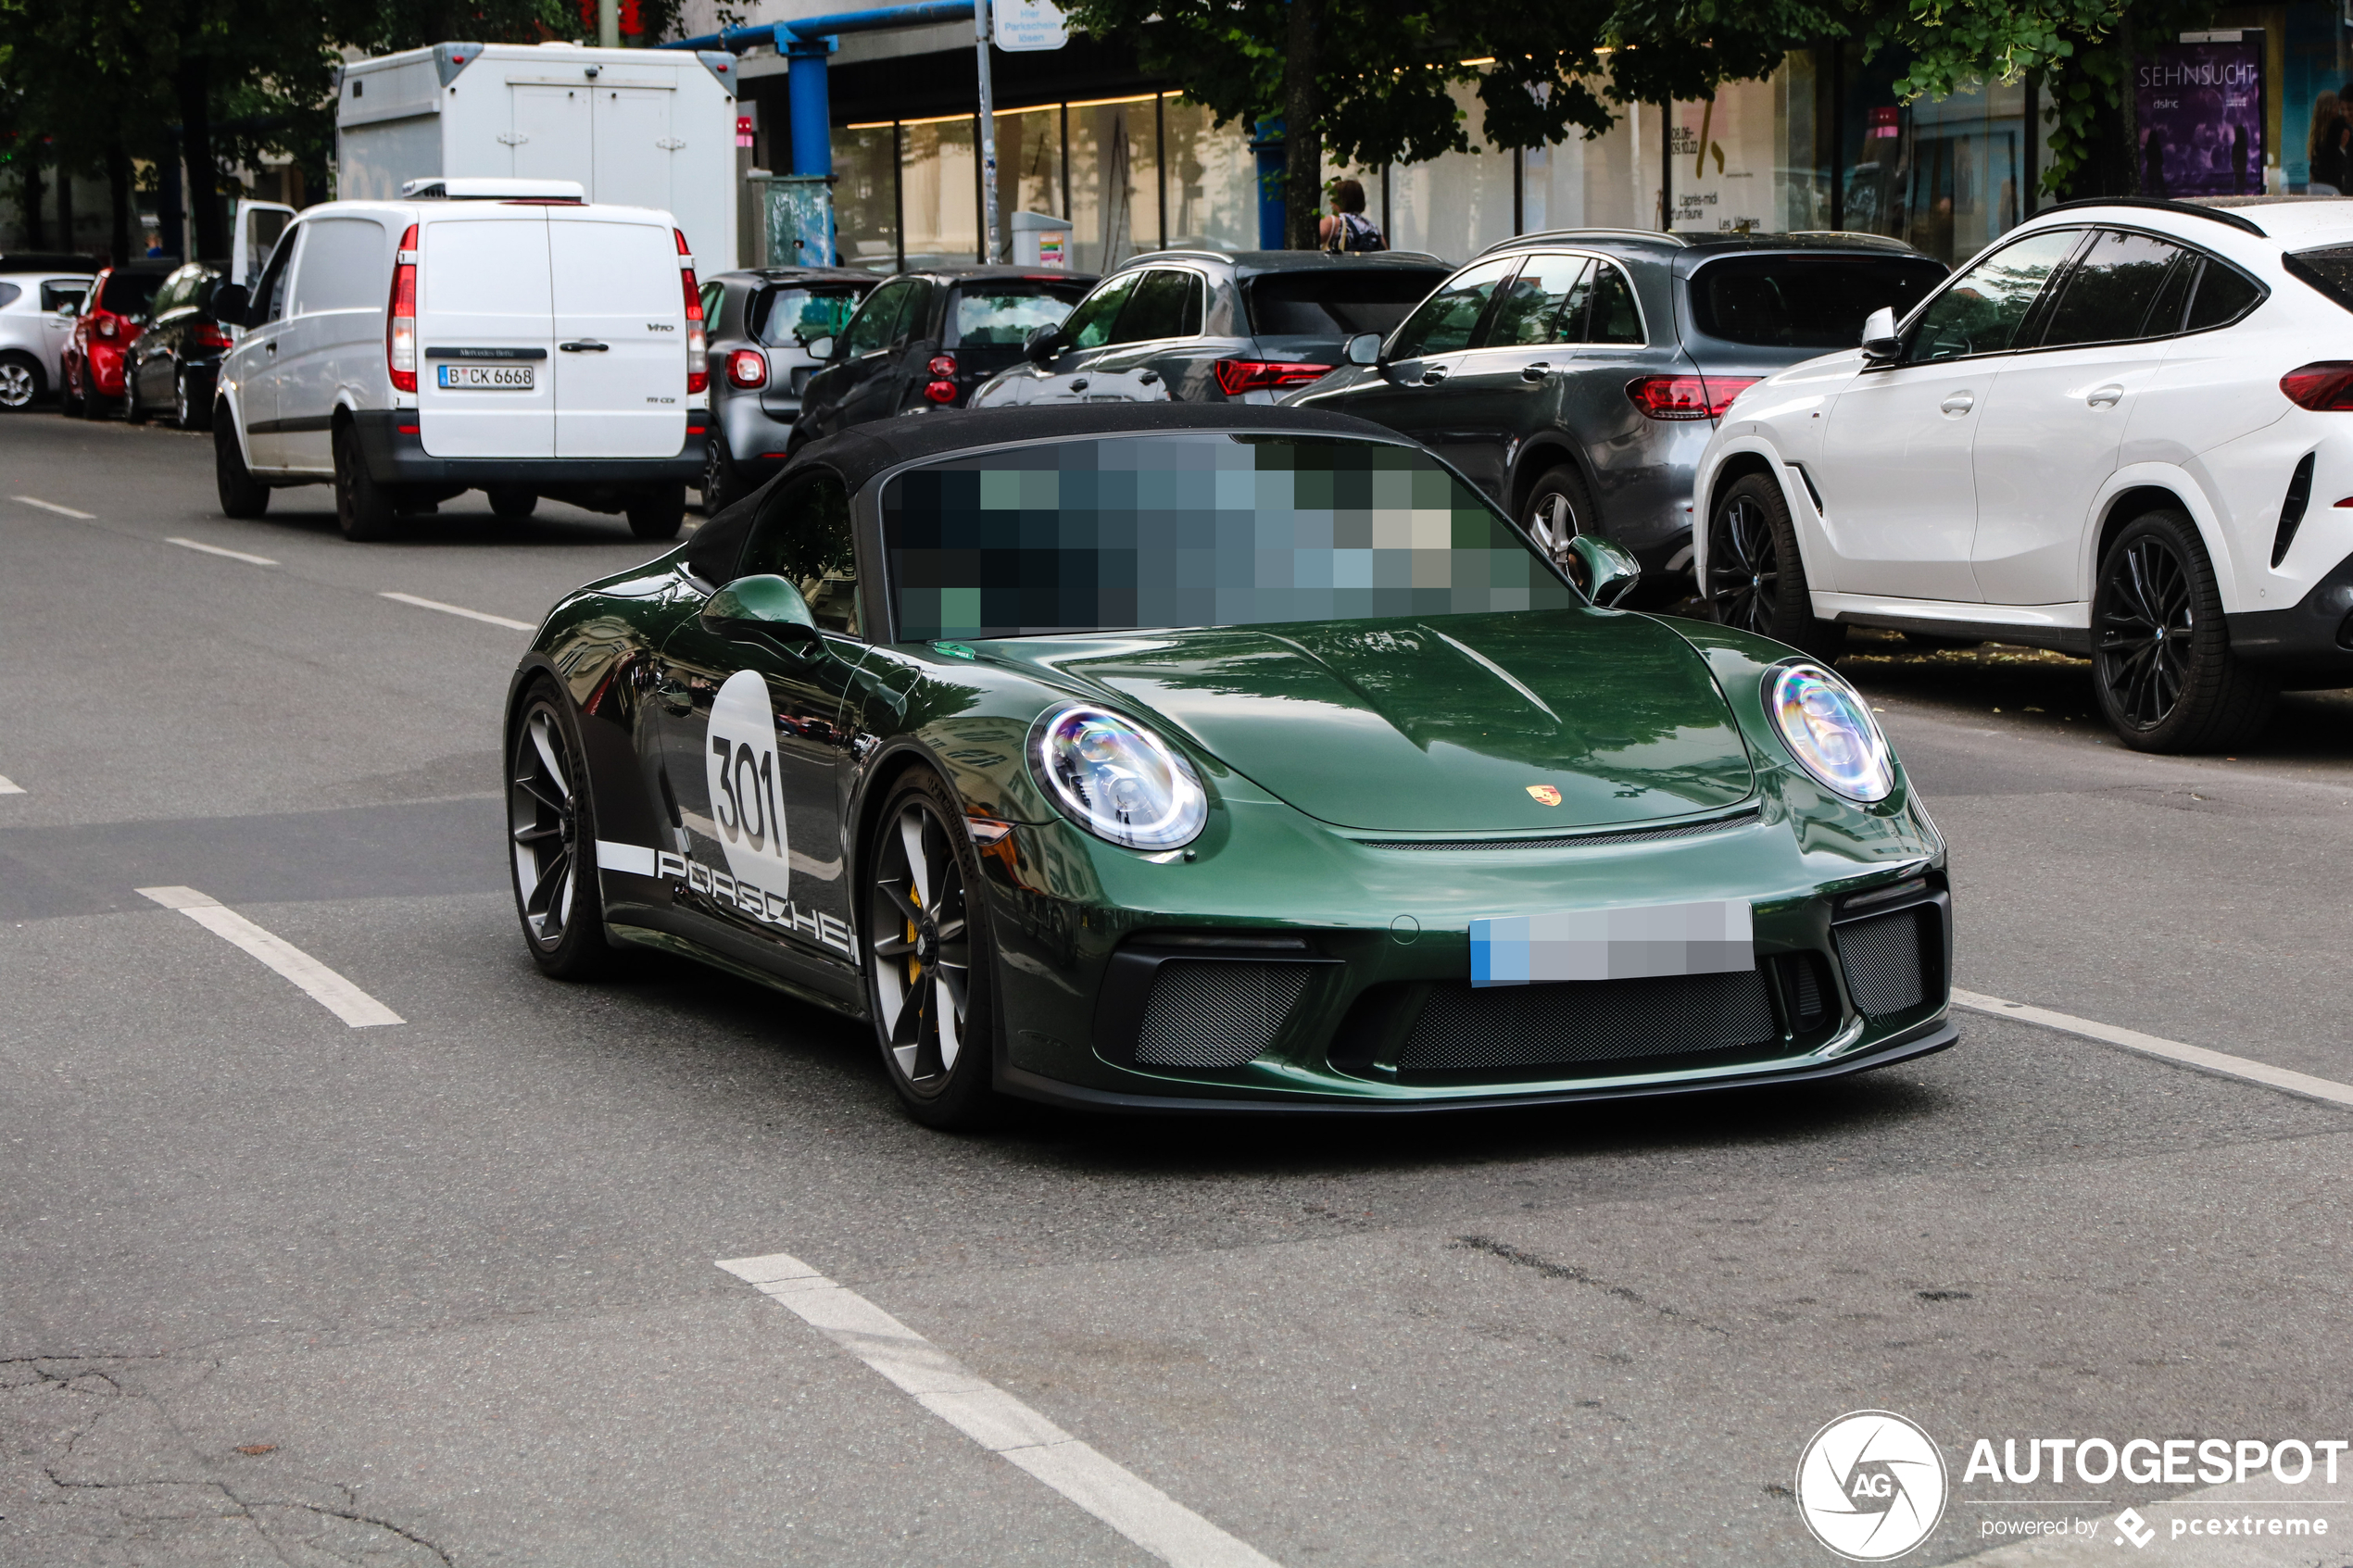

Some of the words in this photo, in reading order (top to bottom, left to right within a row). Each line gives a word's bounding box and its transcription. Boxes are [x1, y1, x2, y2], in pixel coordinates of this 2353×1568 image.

[1020, 9, 1040, 18] Hier
[1004, 21, 1058, 31] Parkschein
[1018, 33, 1045, 43] lösen
[2139, 63, 2255, 87] SEHNSUCHT
[1684, 207, 1704, 220] faune
[1718, 218, 1730, 230] Les
[449, 369, 459, 383] B
[471, 369, 490, 383] CK
[494, 370, 532, 384] 6668
[712, 735, 784, 859] 301
[943, 799, 966, 853] MICHELIN
[658, 849, 850, 954] PORSCHE
